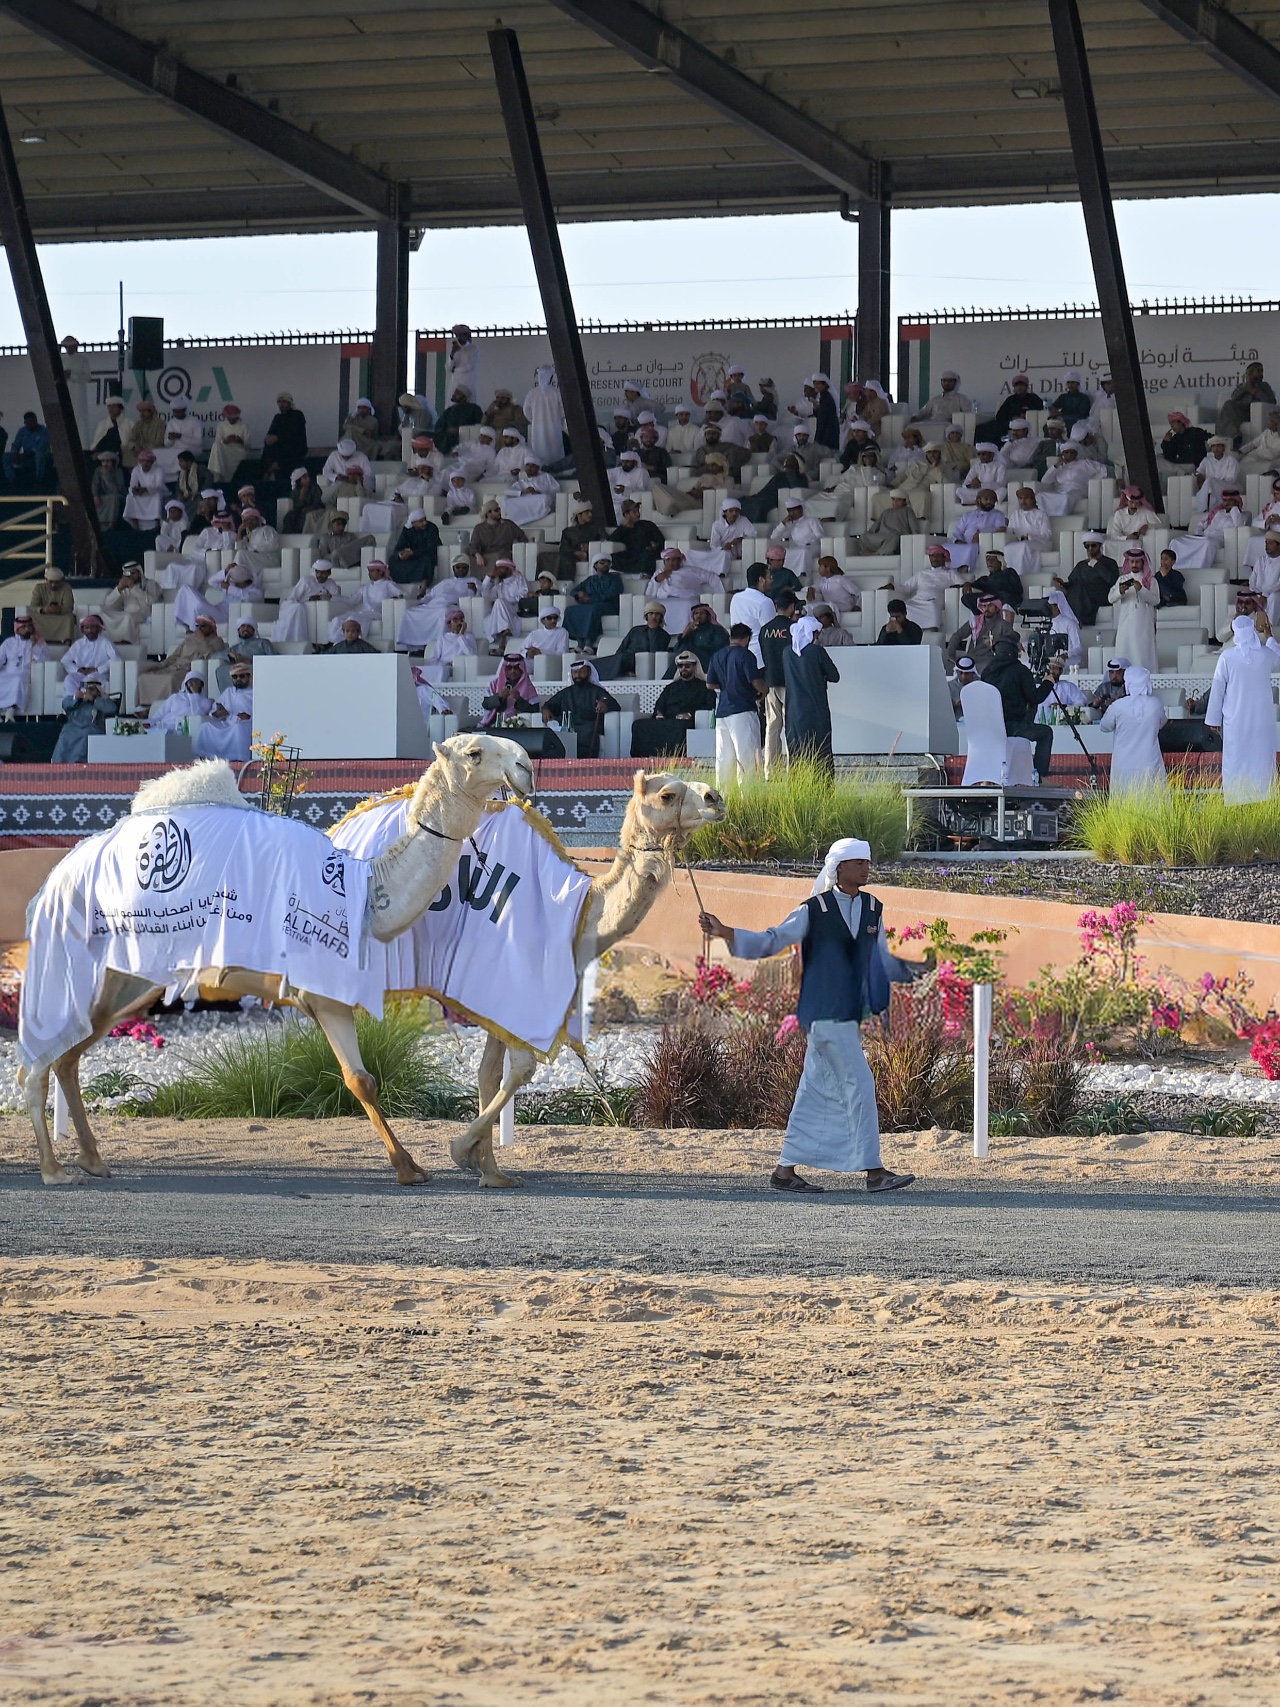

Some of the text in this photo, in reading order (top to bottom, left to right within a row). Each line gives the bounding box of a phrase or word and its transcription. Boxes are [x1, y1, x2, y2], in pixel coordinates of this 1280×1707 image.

[999, 352, 1084, 373] للتراث
[1183, 344, 1259, 366] هيئة
[647, 359, 684, 375] ديوان
[652, 377, 684, 389] COURT
[1040, 378, 1090, 394] Dhi
[593, 396, 620, 407] EGION
[153, 899, 194, 920] أصحاب
[226, 908, 253, 924] ومن
[172, 915, 194, 933] أبناء
[284, 912, 299, 931] AL
